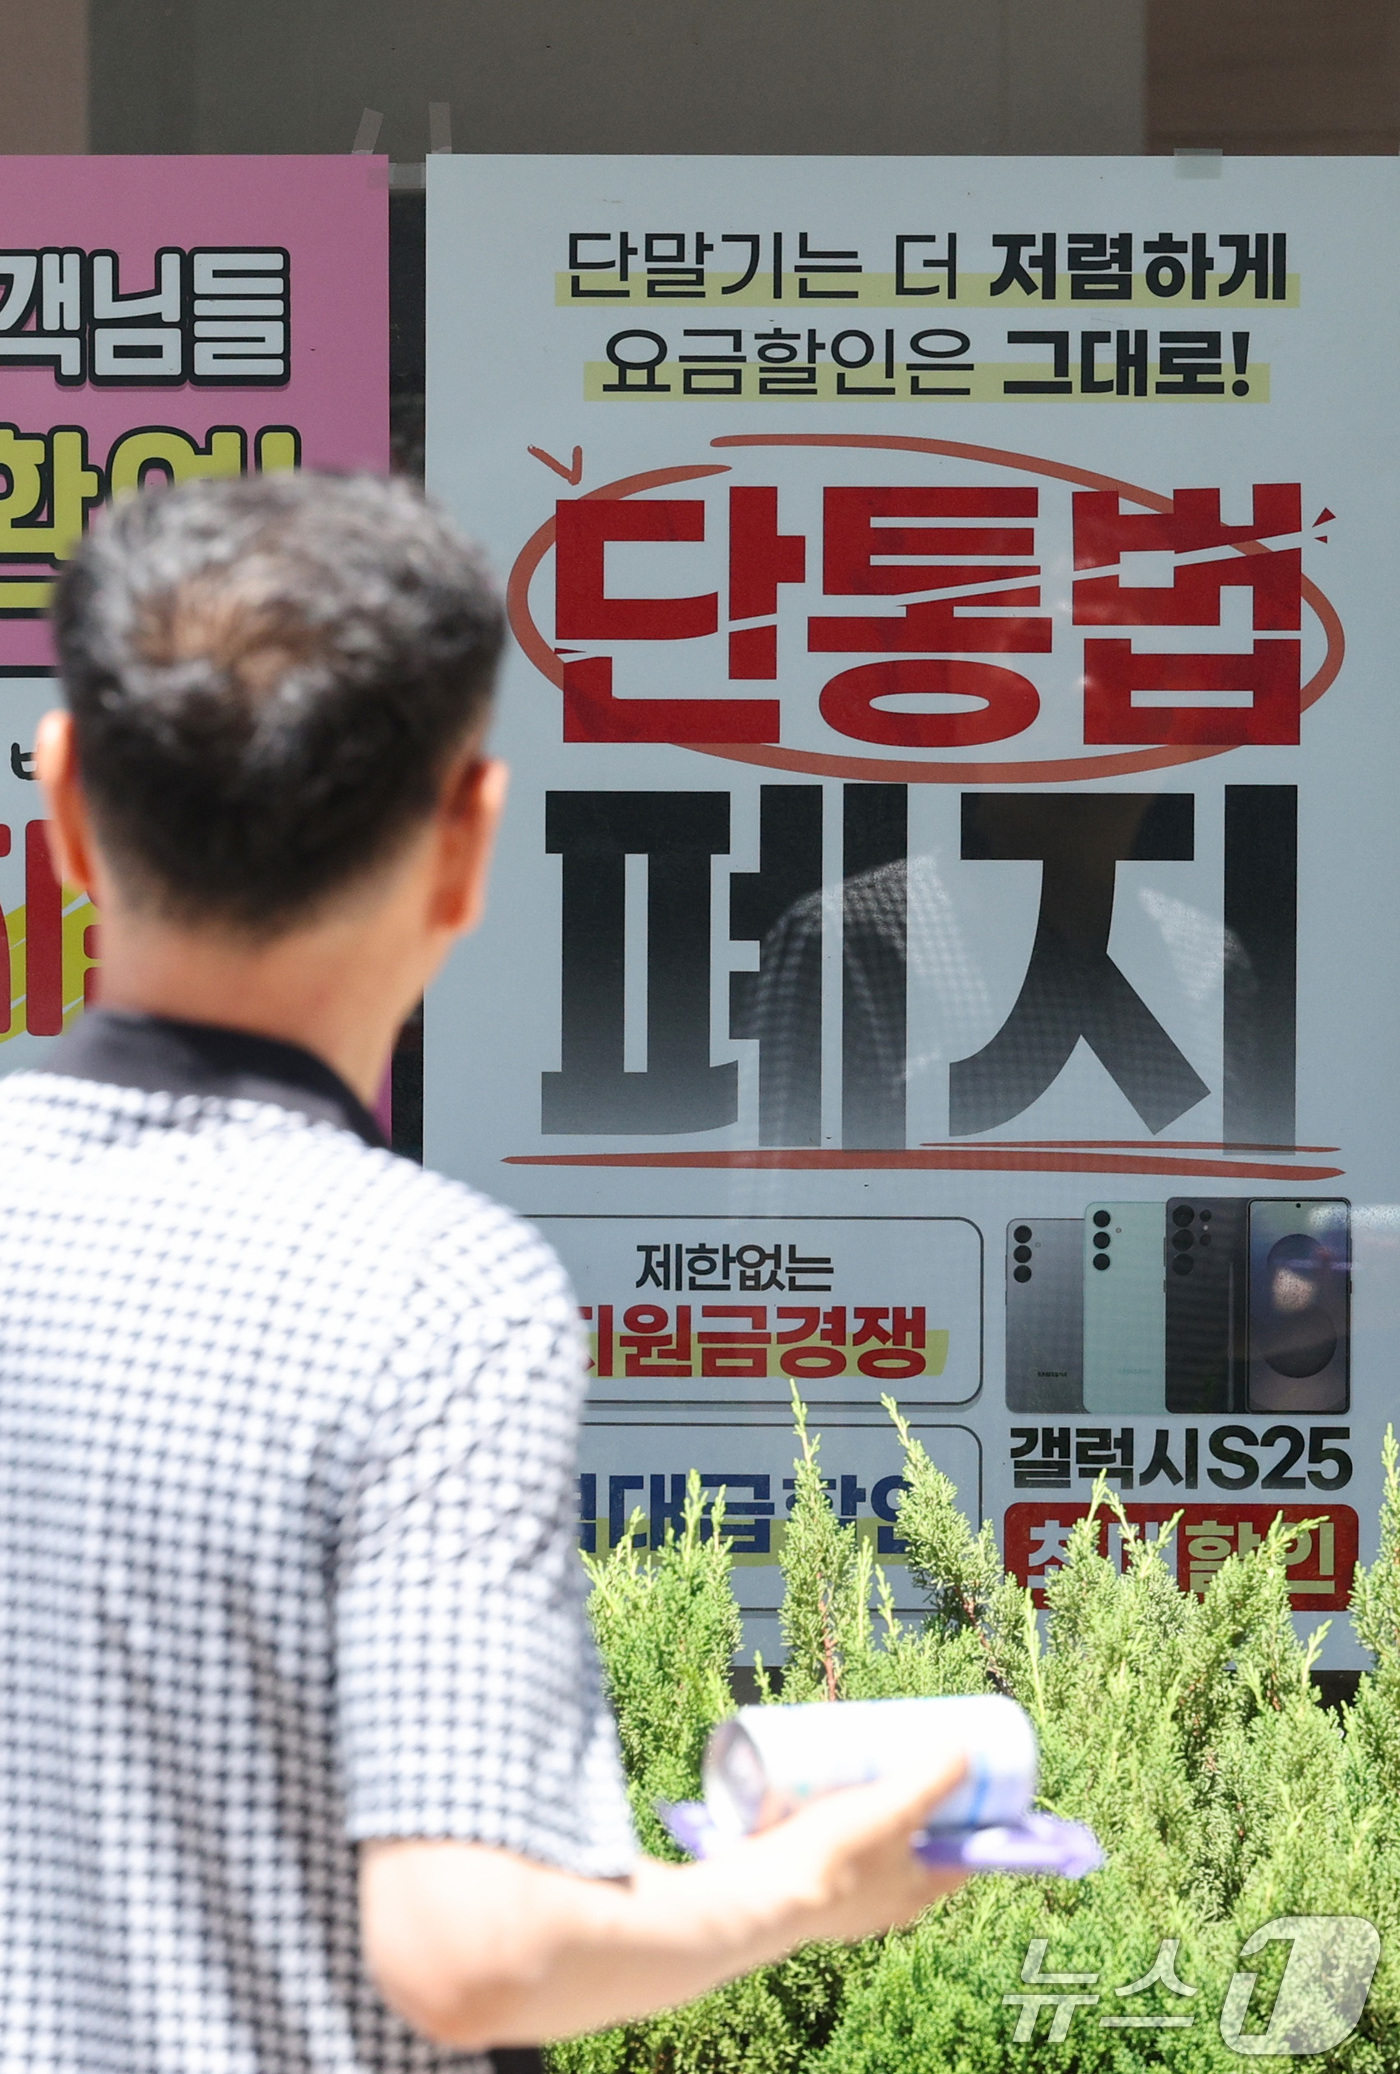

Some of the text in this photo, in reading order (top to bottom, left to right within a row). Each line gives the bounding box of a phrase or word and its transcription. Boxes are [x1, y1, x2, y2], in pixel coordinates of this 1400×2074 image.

[569, 231, 1288, 302] 단말기는 더 저렴하게
[0, 247, 290, 386] 객님들
[602, 327, 1252, 398] 요금할인은 그대로!
[554, 482, 1303, 747] 단통법
[540, 783, 1299, 1156] 폐지
[635, 1242, 835, 1293] 제한없는
[1009, 1425, 1354, 1491] 갤럭시S25
